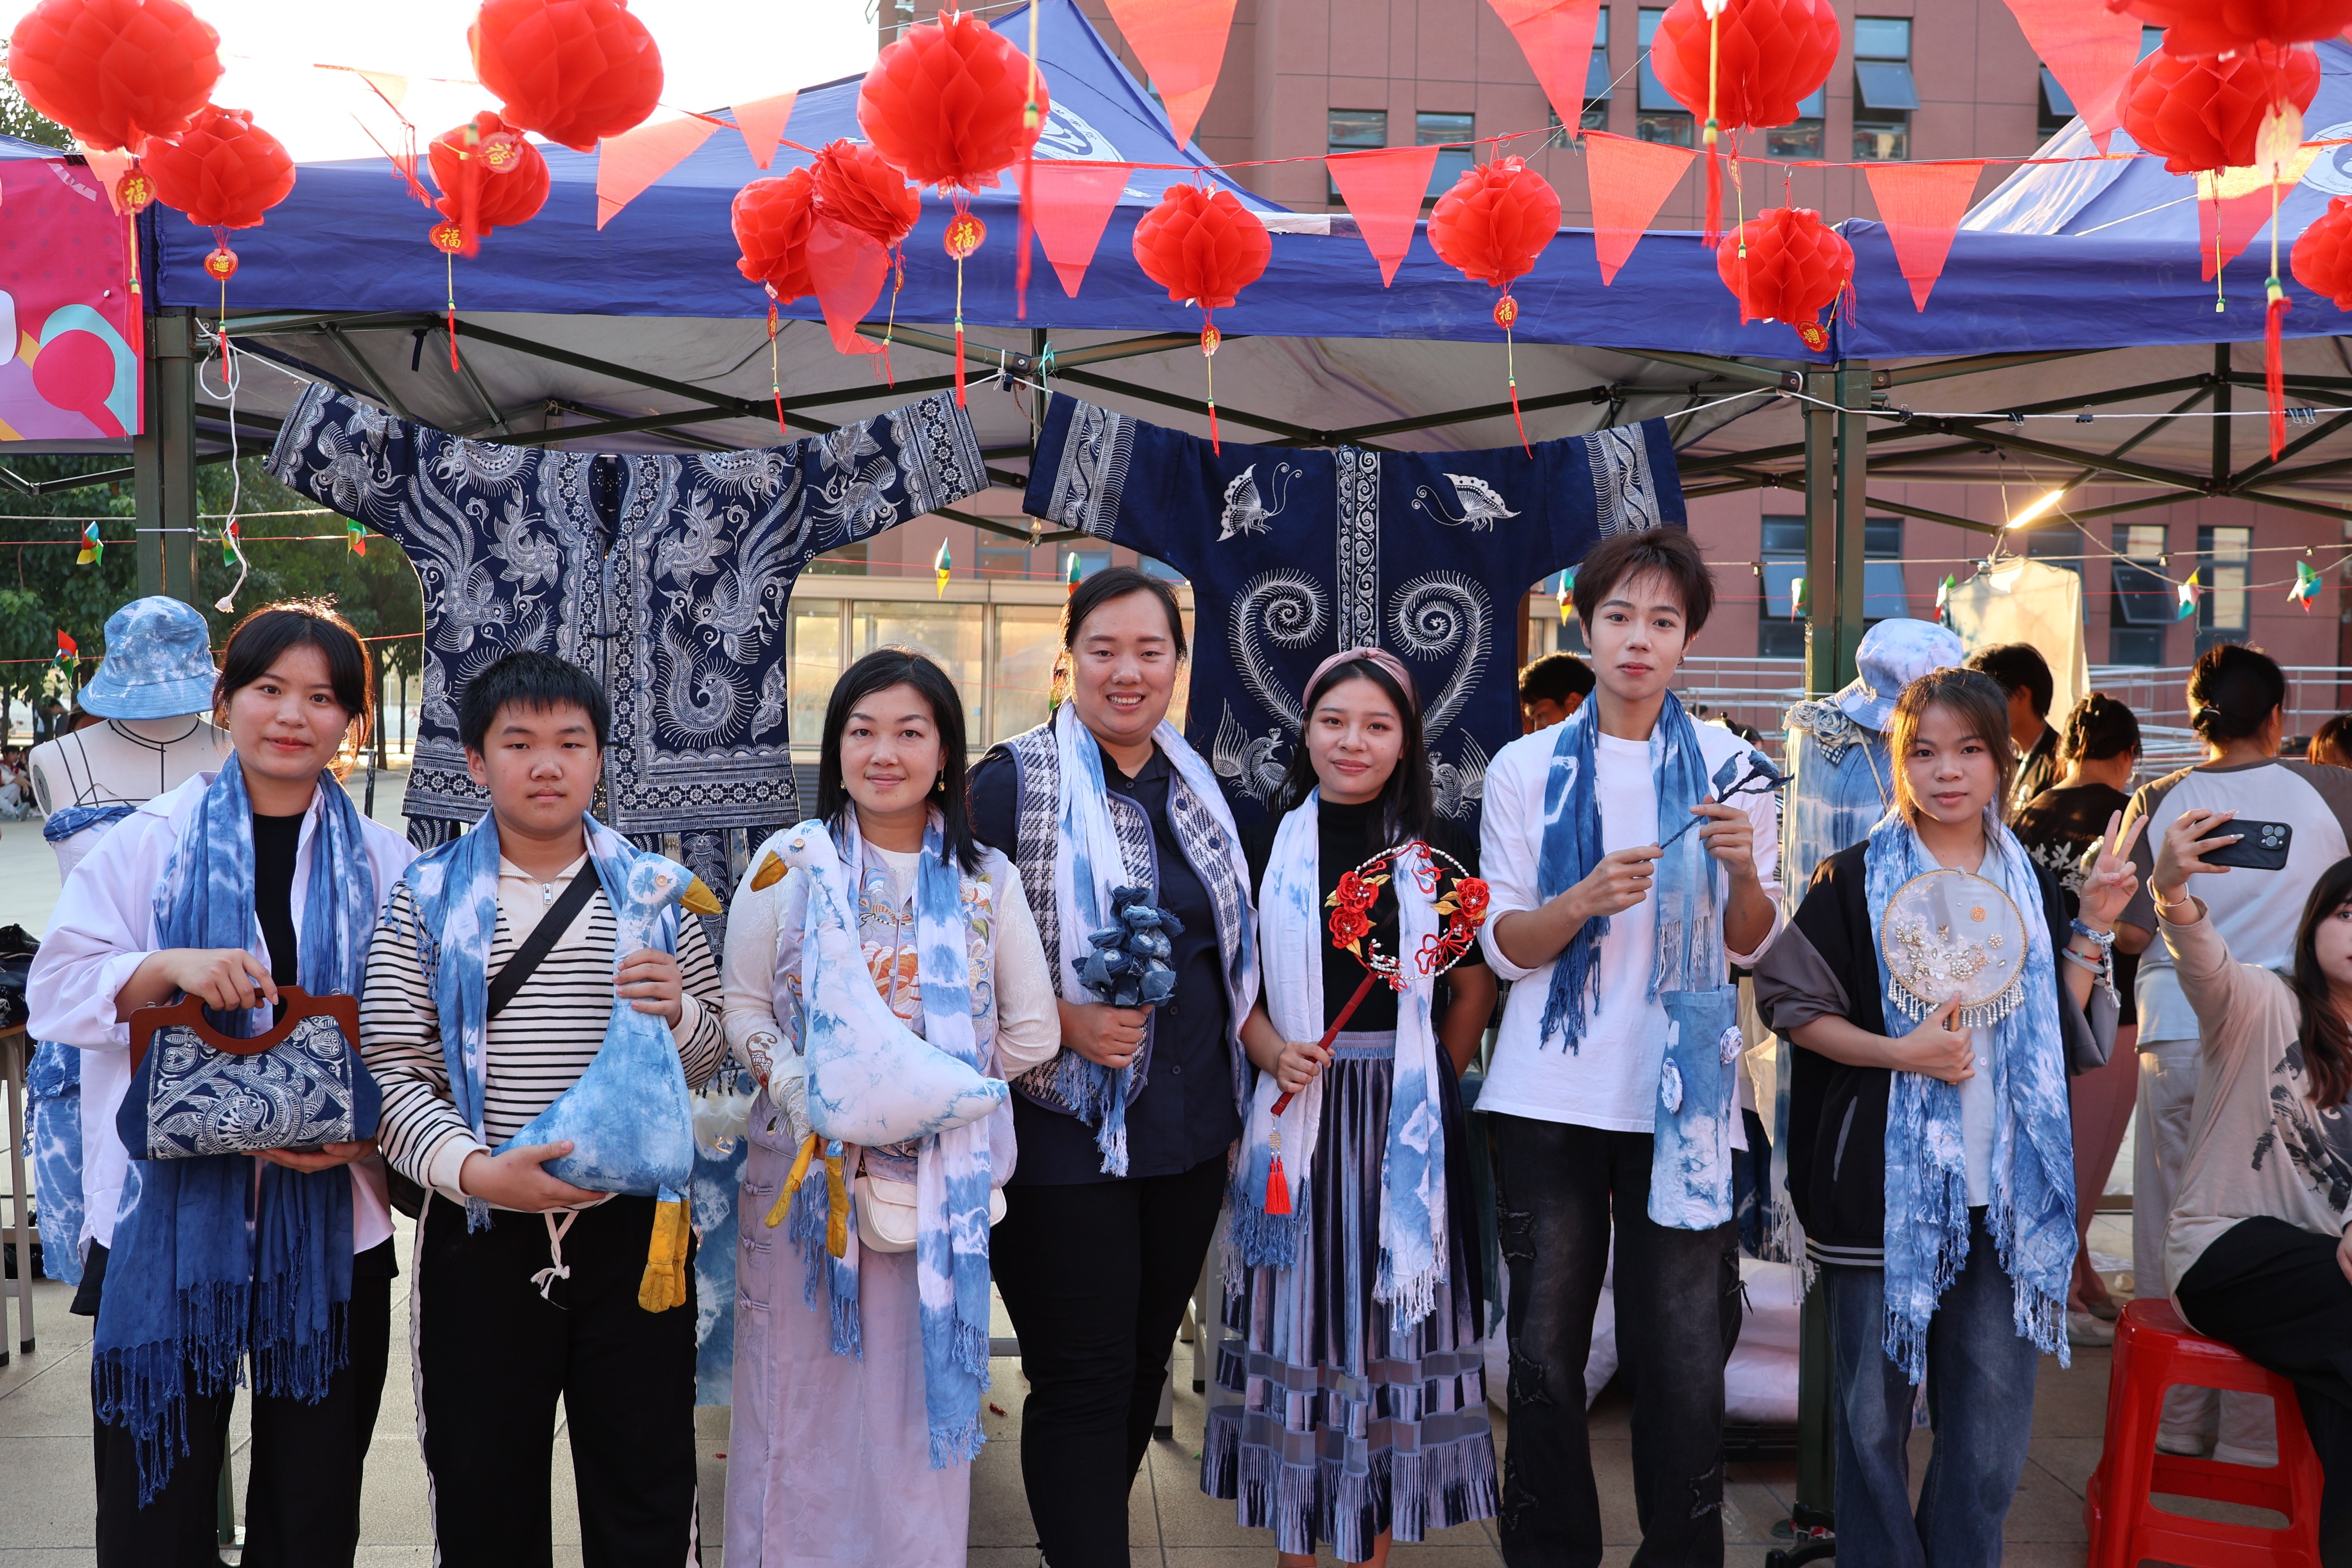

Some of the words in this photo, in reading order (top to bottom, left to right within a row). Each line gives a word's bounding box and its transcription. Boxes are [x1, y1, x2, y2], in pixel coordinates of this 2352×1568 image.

[125, 177, 147, 206] 福
[439, 227, 461, 248] 福
[953, 222, 976, 251] 福
[1498, 302, 1512, 323] 福
[1205, 330, 1216, 350] 福
